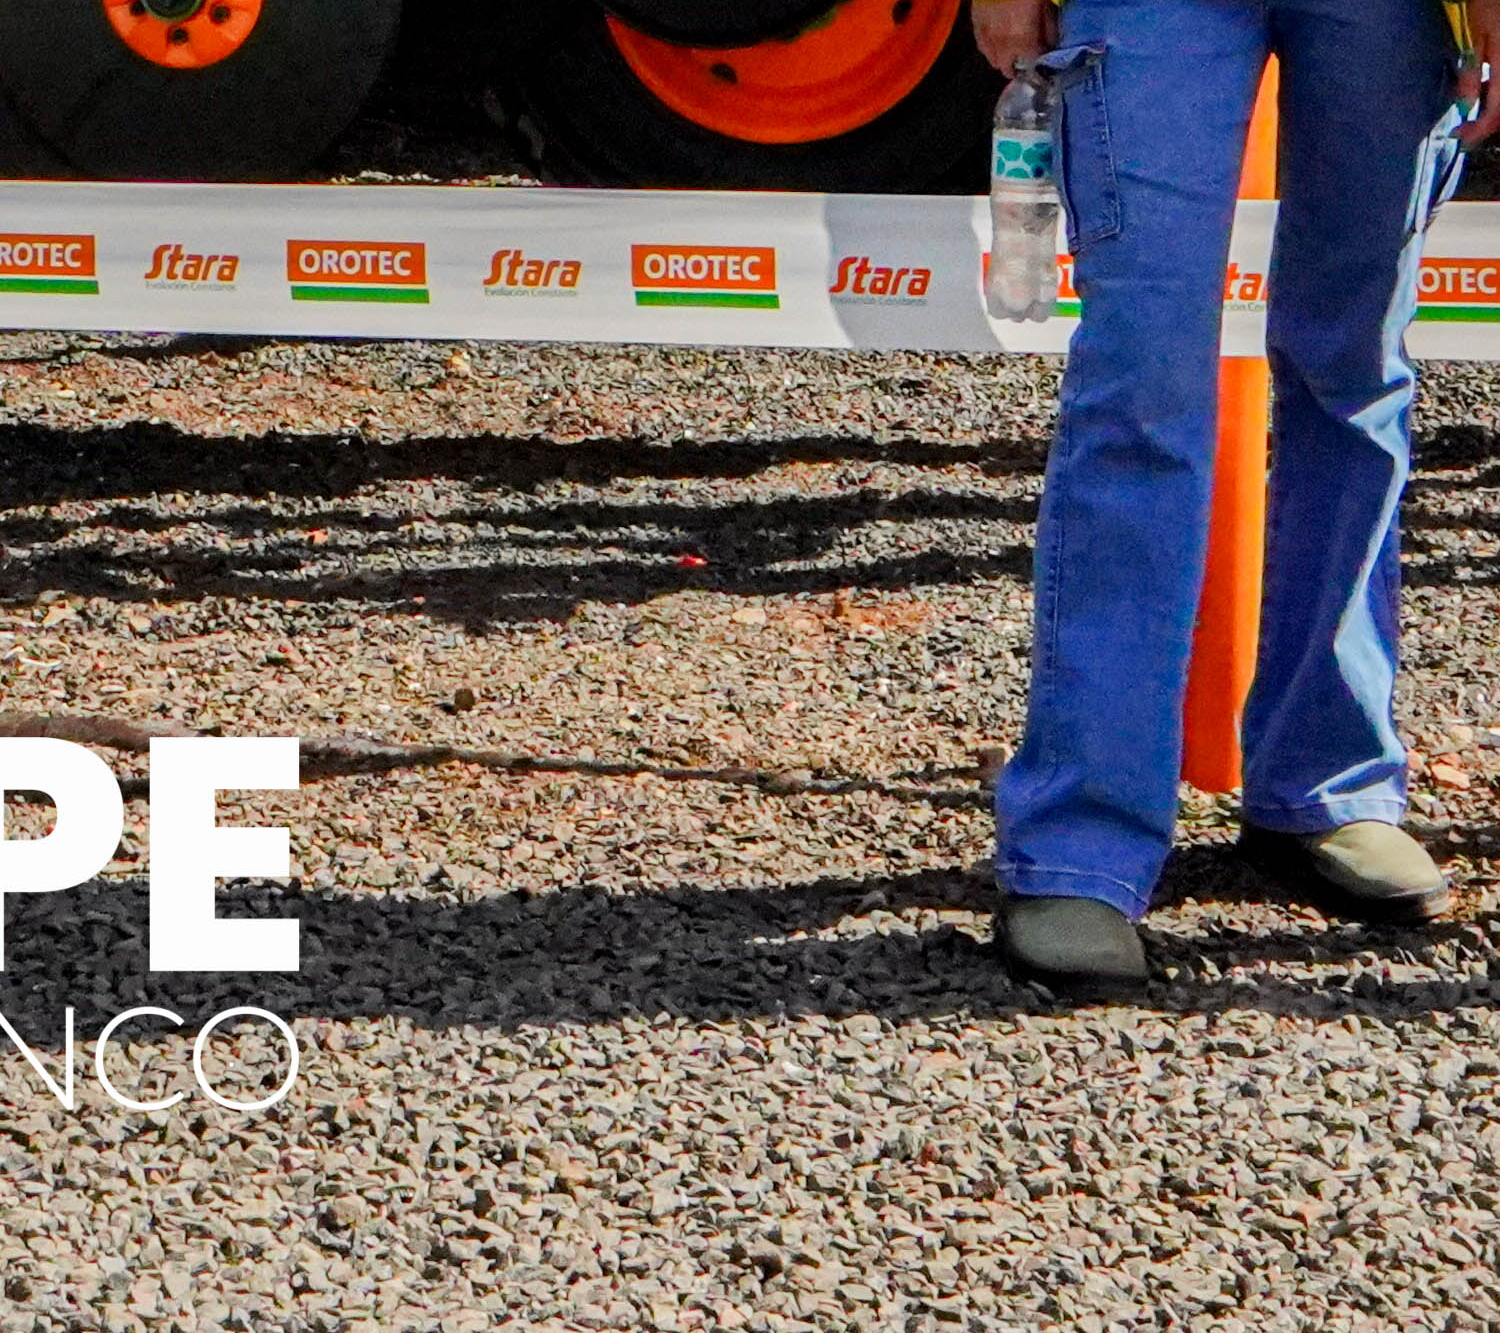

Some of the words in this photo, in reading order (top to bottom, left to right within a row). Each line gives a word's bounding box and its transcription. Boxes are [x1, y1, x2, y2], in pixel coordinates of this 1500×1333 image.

[145, 244, 240, 283] Stara
[299, 249, 412, 276] OROTEC
[484, 250, 583, 288] Stara
[643, 254, 761, 282] OROTEC
[829, 256, 932, 297] Stara
[1417, 266, 1498, 294] OTEC
